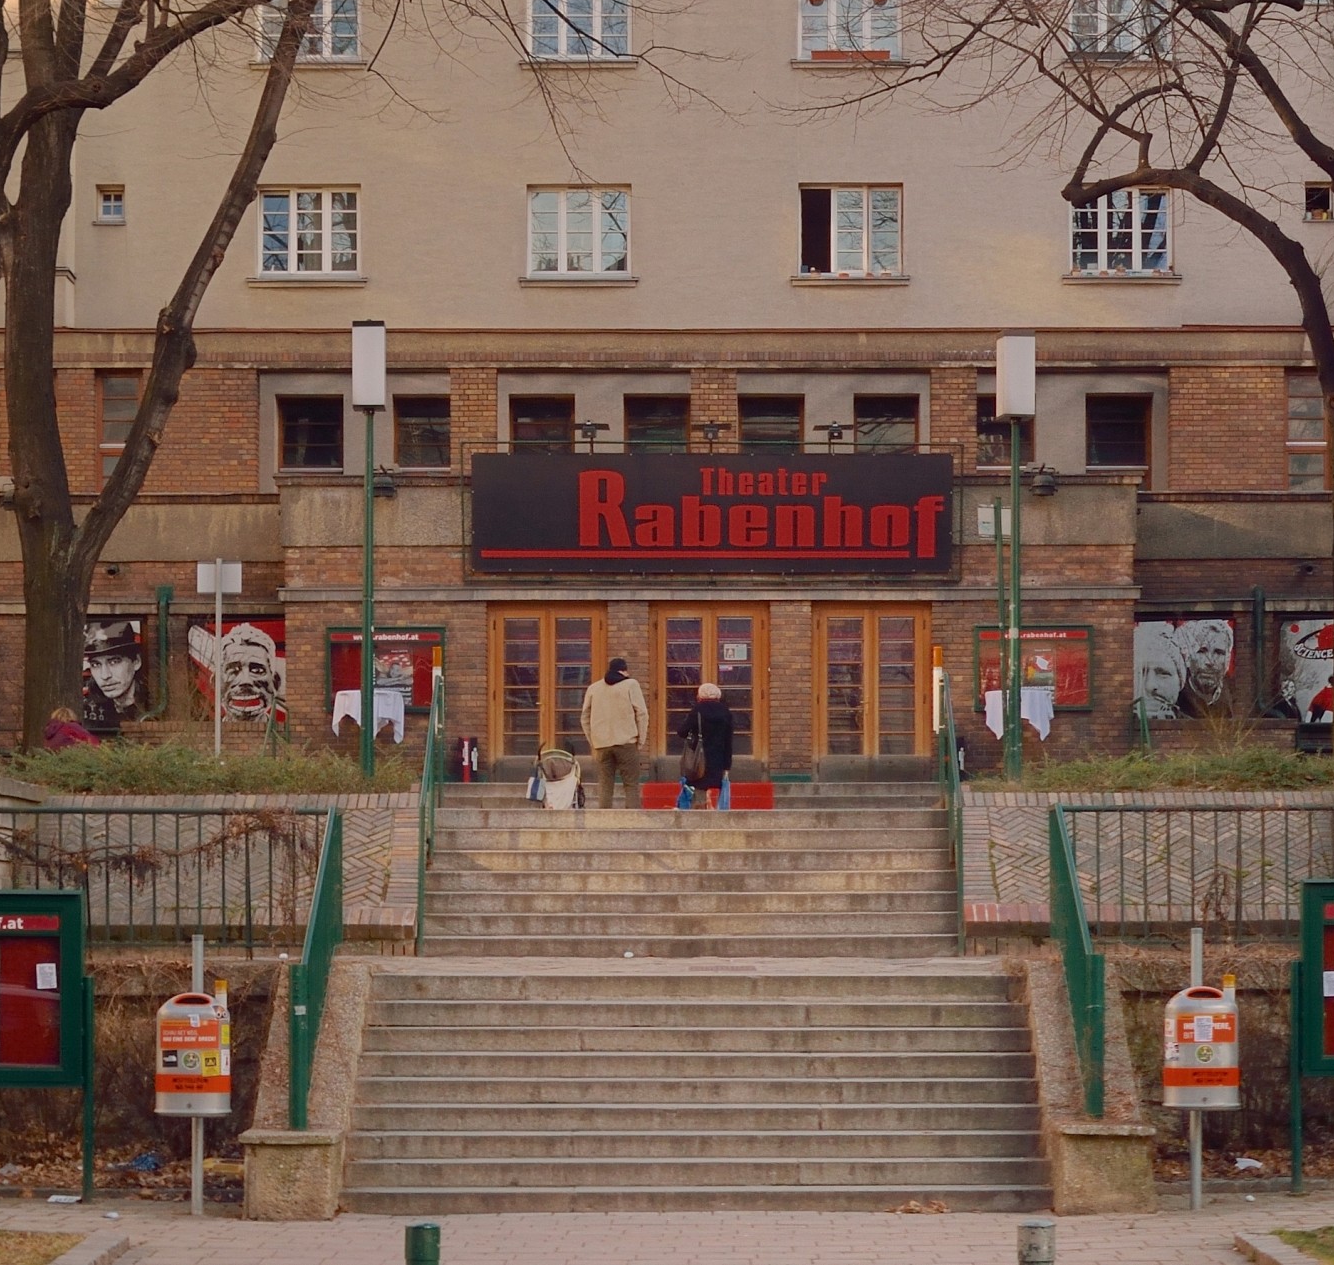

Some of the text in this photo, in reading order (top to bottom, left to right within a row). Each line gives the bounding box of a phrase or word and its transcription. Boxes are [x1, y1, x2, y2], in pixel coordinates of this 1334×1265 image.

[699, 467, 829, 496] Theater
[578, 469, 946, 559] Rabenhof
[1293, 642, 1334, 659] SCIENCE
